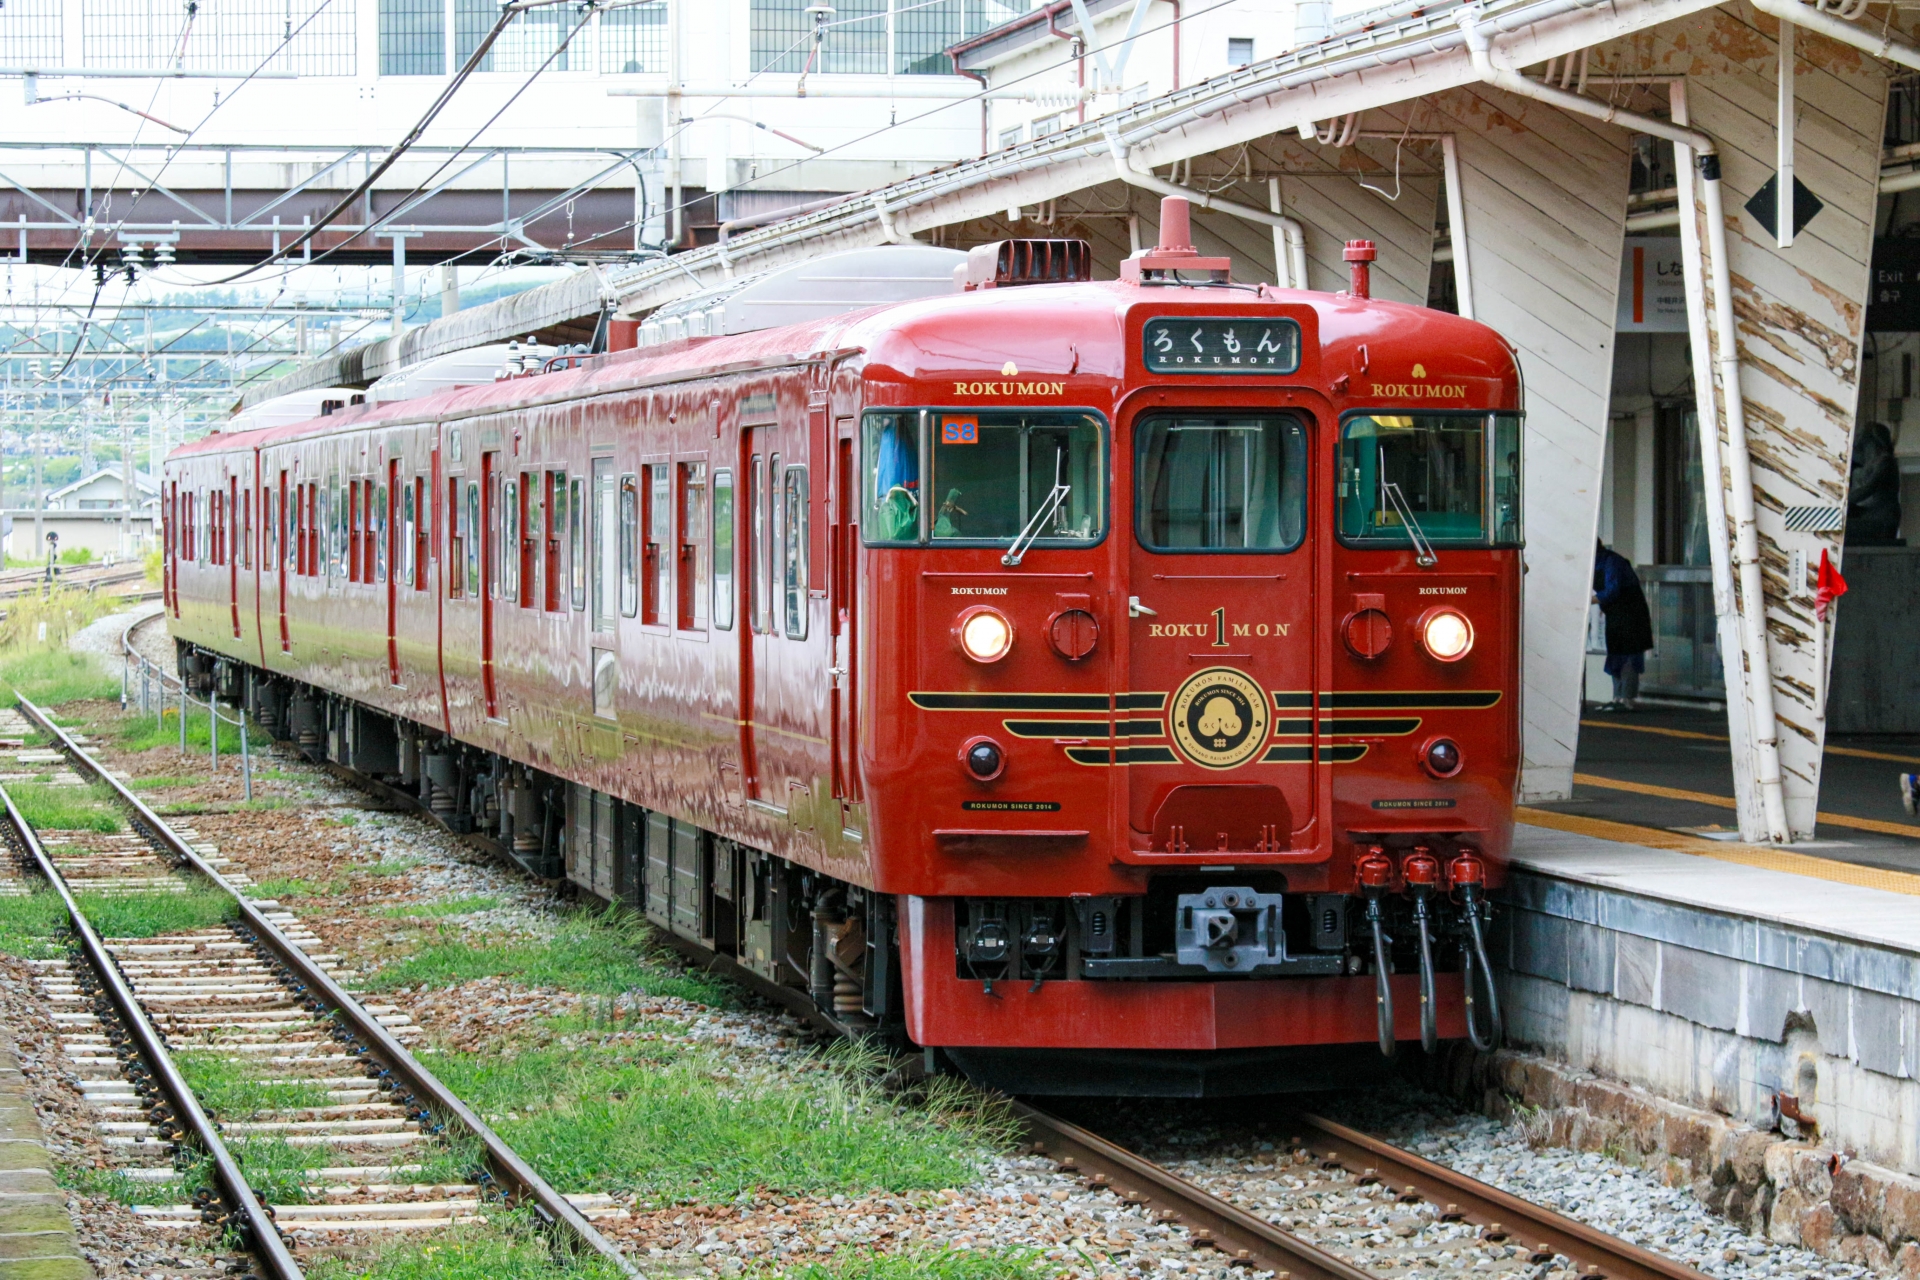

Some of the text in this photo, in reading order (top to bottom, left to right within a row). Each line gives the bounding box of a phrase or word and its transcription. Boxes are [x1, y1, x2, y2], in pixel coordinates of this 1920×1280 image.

[1879, 270, 1903, 283] Exit
[1154, 328, 1281, 353] ろくもん
[953, 382, 1067, 395] ROKUMON
[1371, 383, 1467, 398] ROKUMON
[945, 423, 975, 441] S8
[951, 587, 1008, 595] ROKUMON
[1419, 587, 1468, 595] ROKUMON
[1149, 607, 1290, 647] ROKU 1 MON
[1181, 676, 1260, 709] ROKUMON FAMILY CAR
[1195, 689, 1246, 706] ROKUMON SINCE 2014
[1188, 743, 1209, 758] SHINANO
